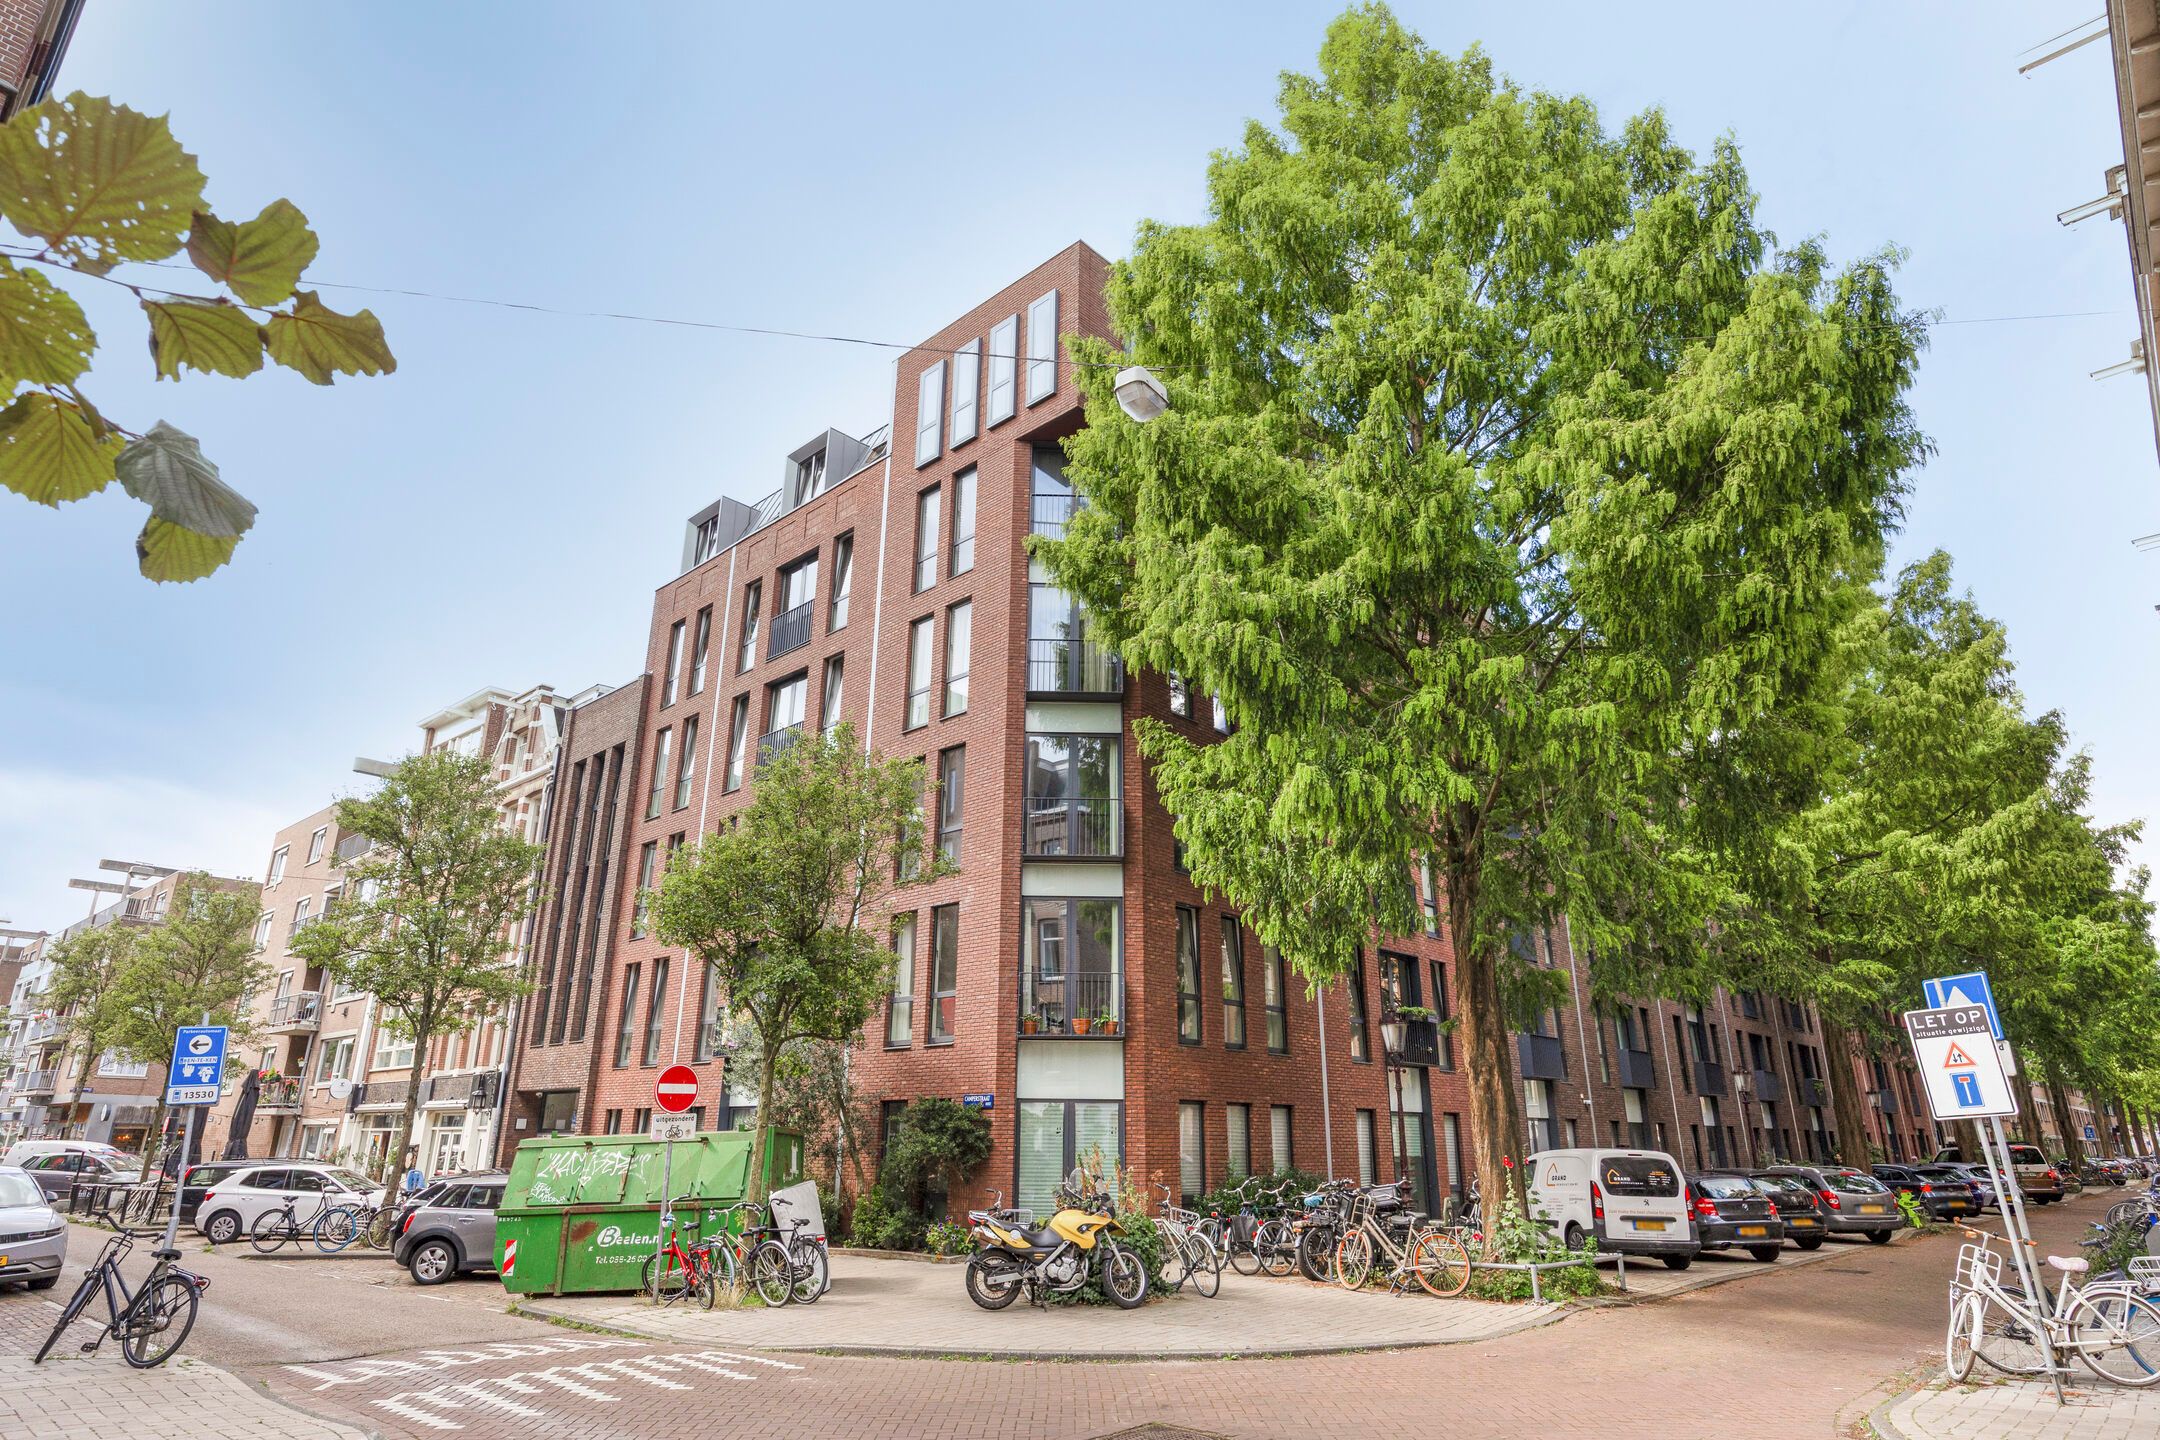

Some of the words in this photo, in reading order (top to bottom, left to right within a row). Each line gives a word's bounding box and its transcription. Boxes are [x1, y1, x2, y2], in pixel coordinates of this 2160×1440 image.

[1912, 1013, 1947, 1029] LET
[1955, 1010, 1981, 1024] OP
[1916, 1028, 1946, 1038] situatie
[1948, 1025, 1986, 1036] gewijzigd
[184, 1090, 214, 1099] 13530
